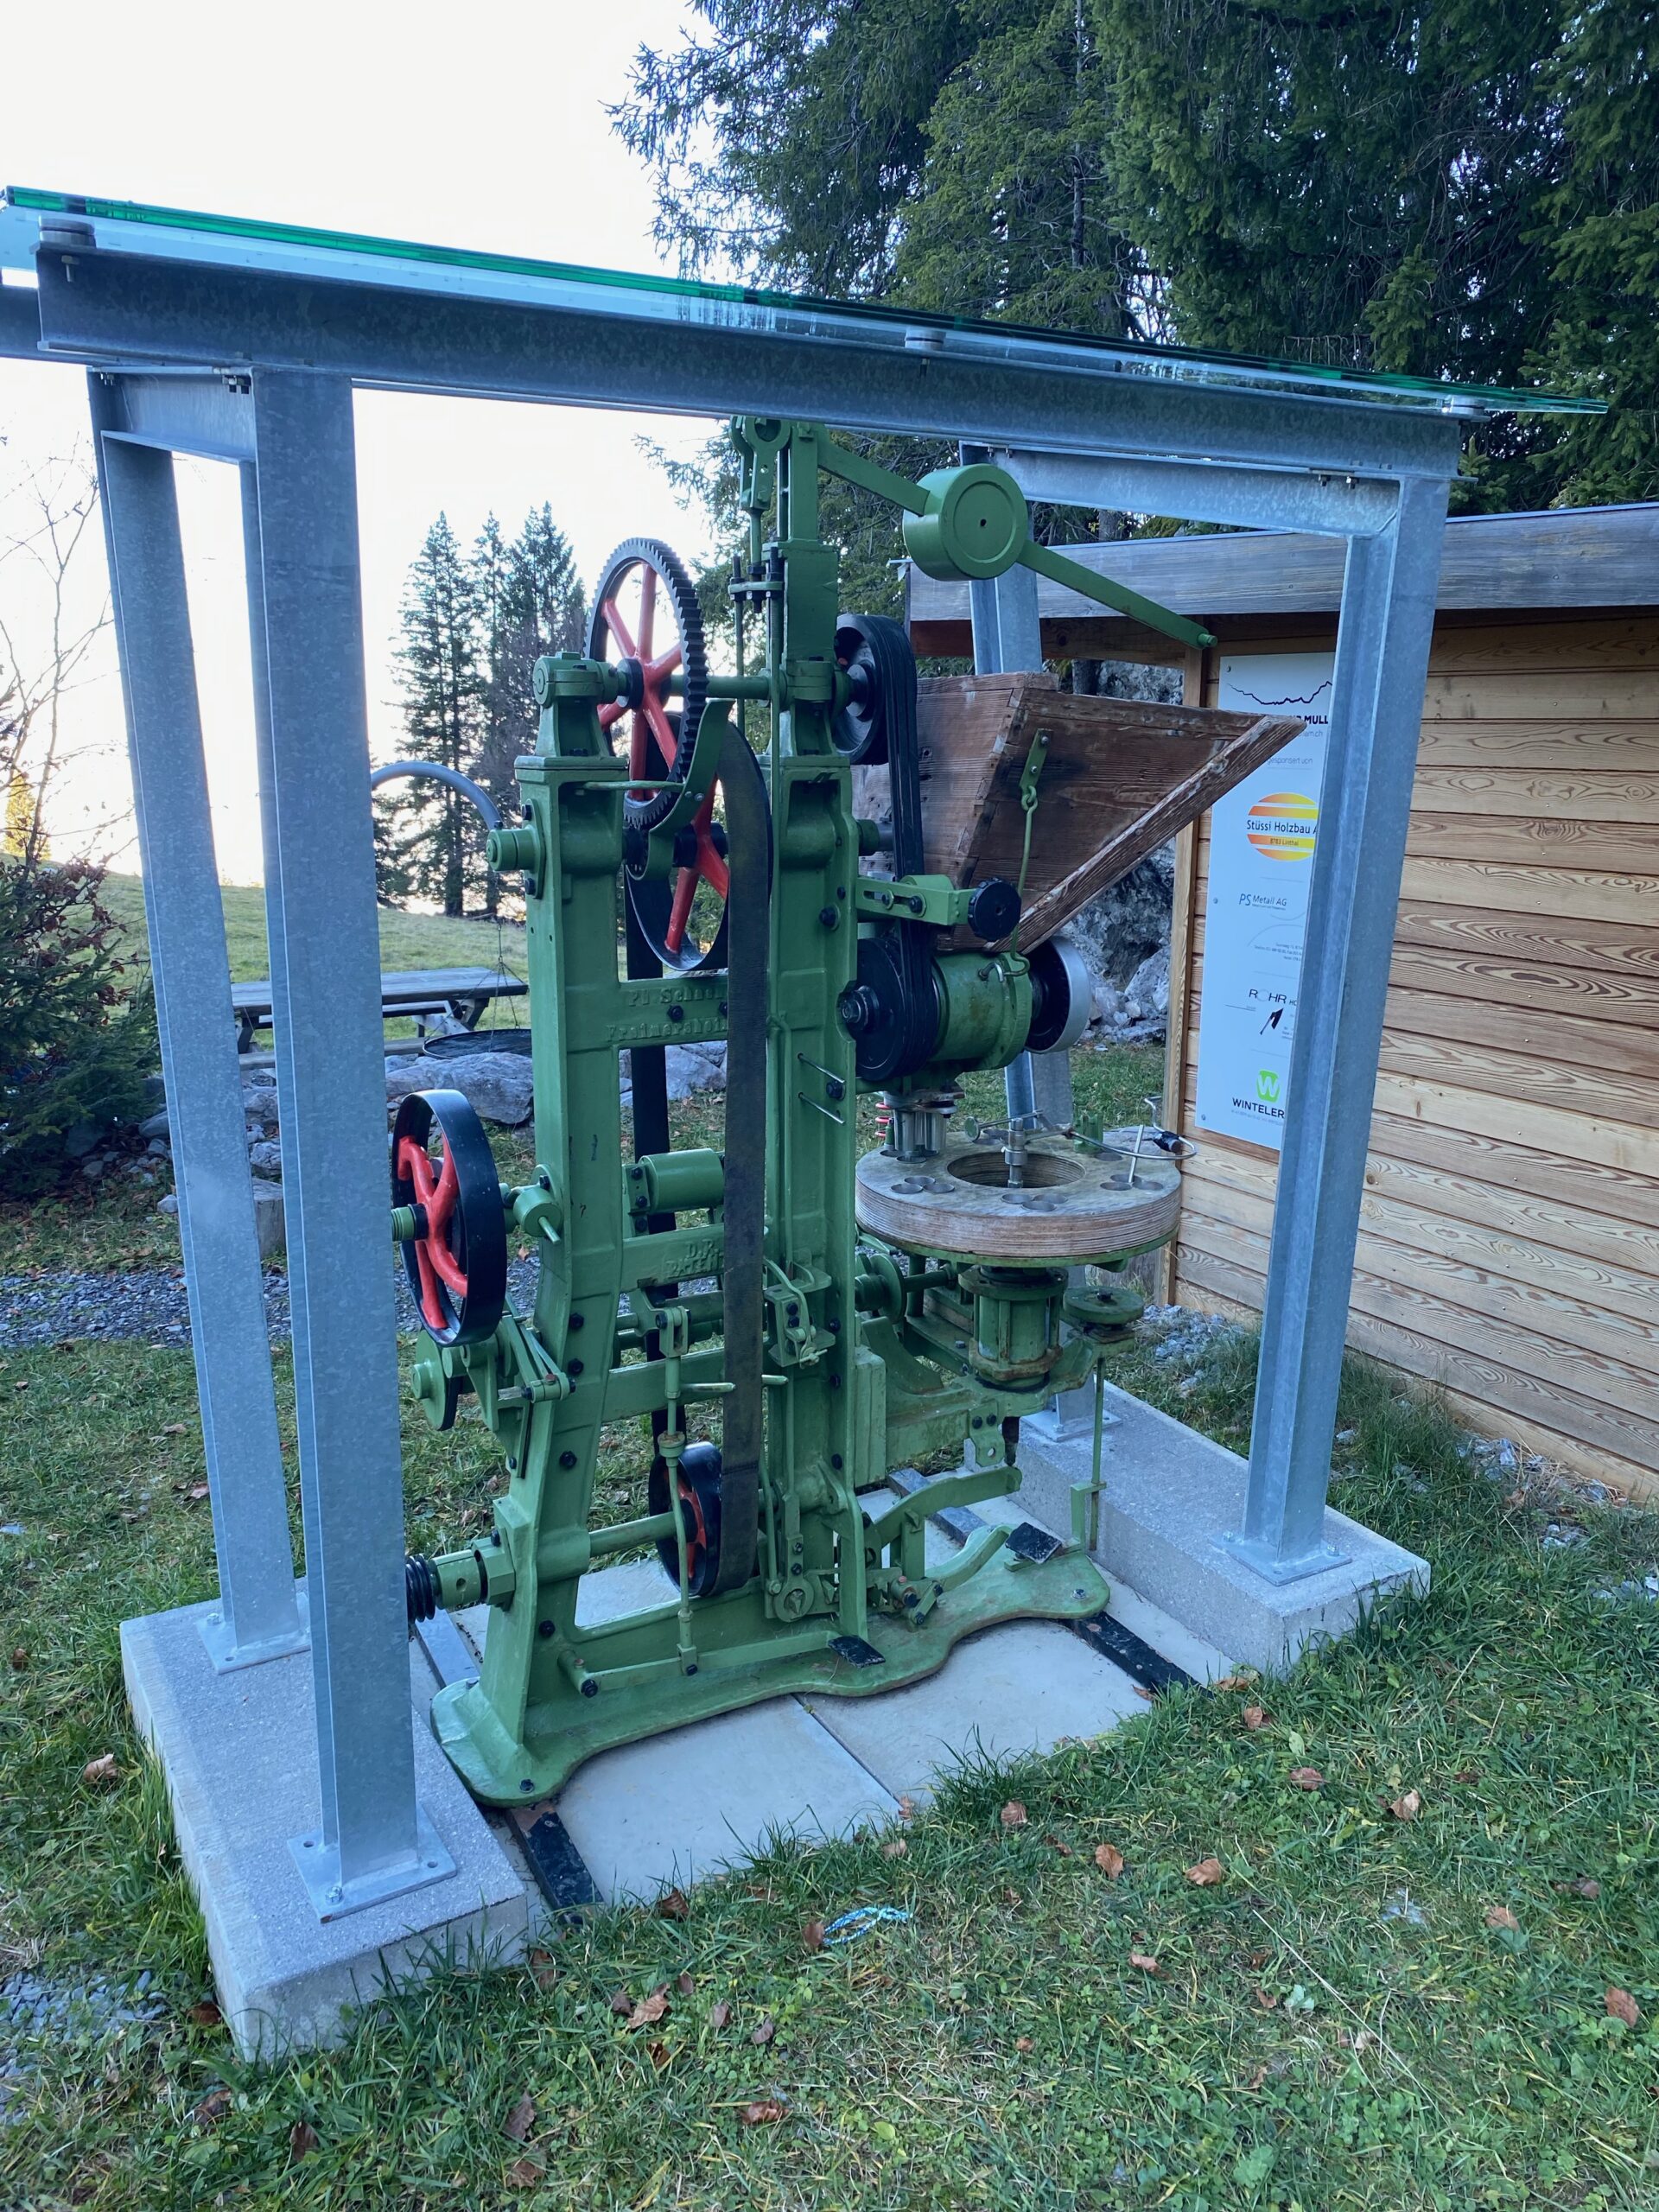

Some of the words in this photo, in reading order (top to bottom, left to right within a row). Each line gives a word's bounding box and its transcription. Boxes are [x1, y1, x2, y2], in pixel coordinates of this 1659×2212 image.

[1247, 819, 1271, 832] Stüssi
[1274, 822, 1311, 835] Holzbau
[1239, 893, 1251, 906] PS
[1252, 894, 1274, 906] Metall
[1276, 898, 1287, 906] AG
[1249, 988, 1287, 1004] ROHR
[1232, 1096, 1285, 1119] WINTELER
